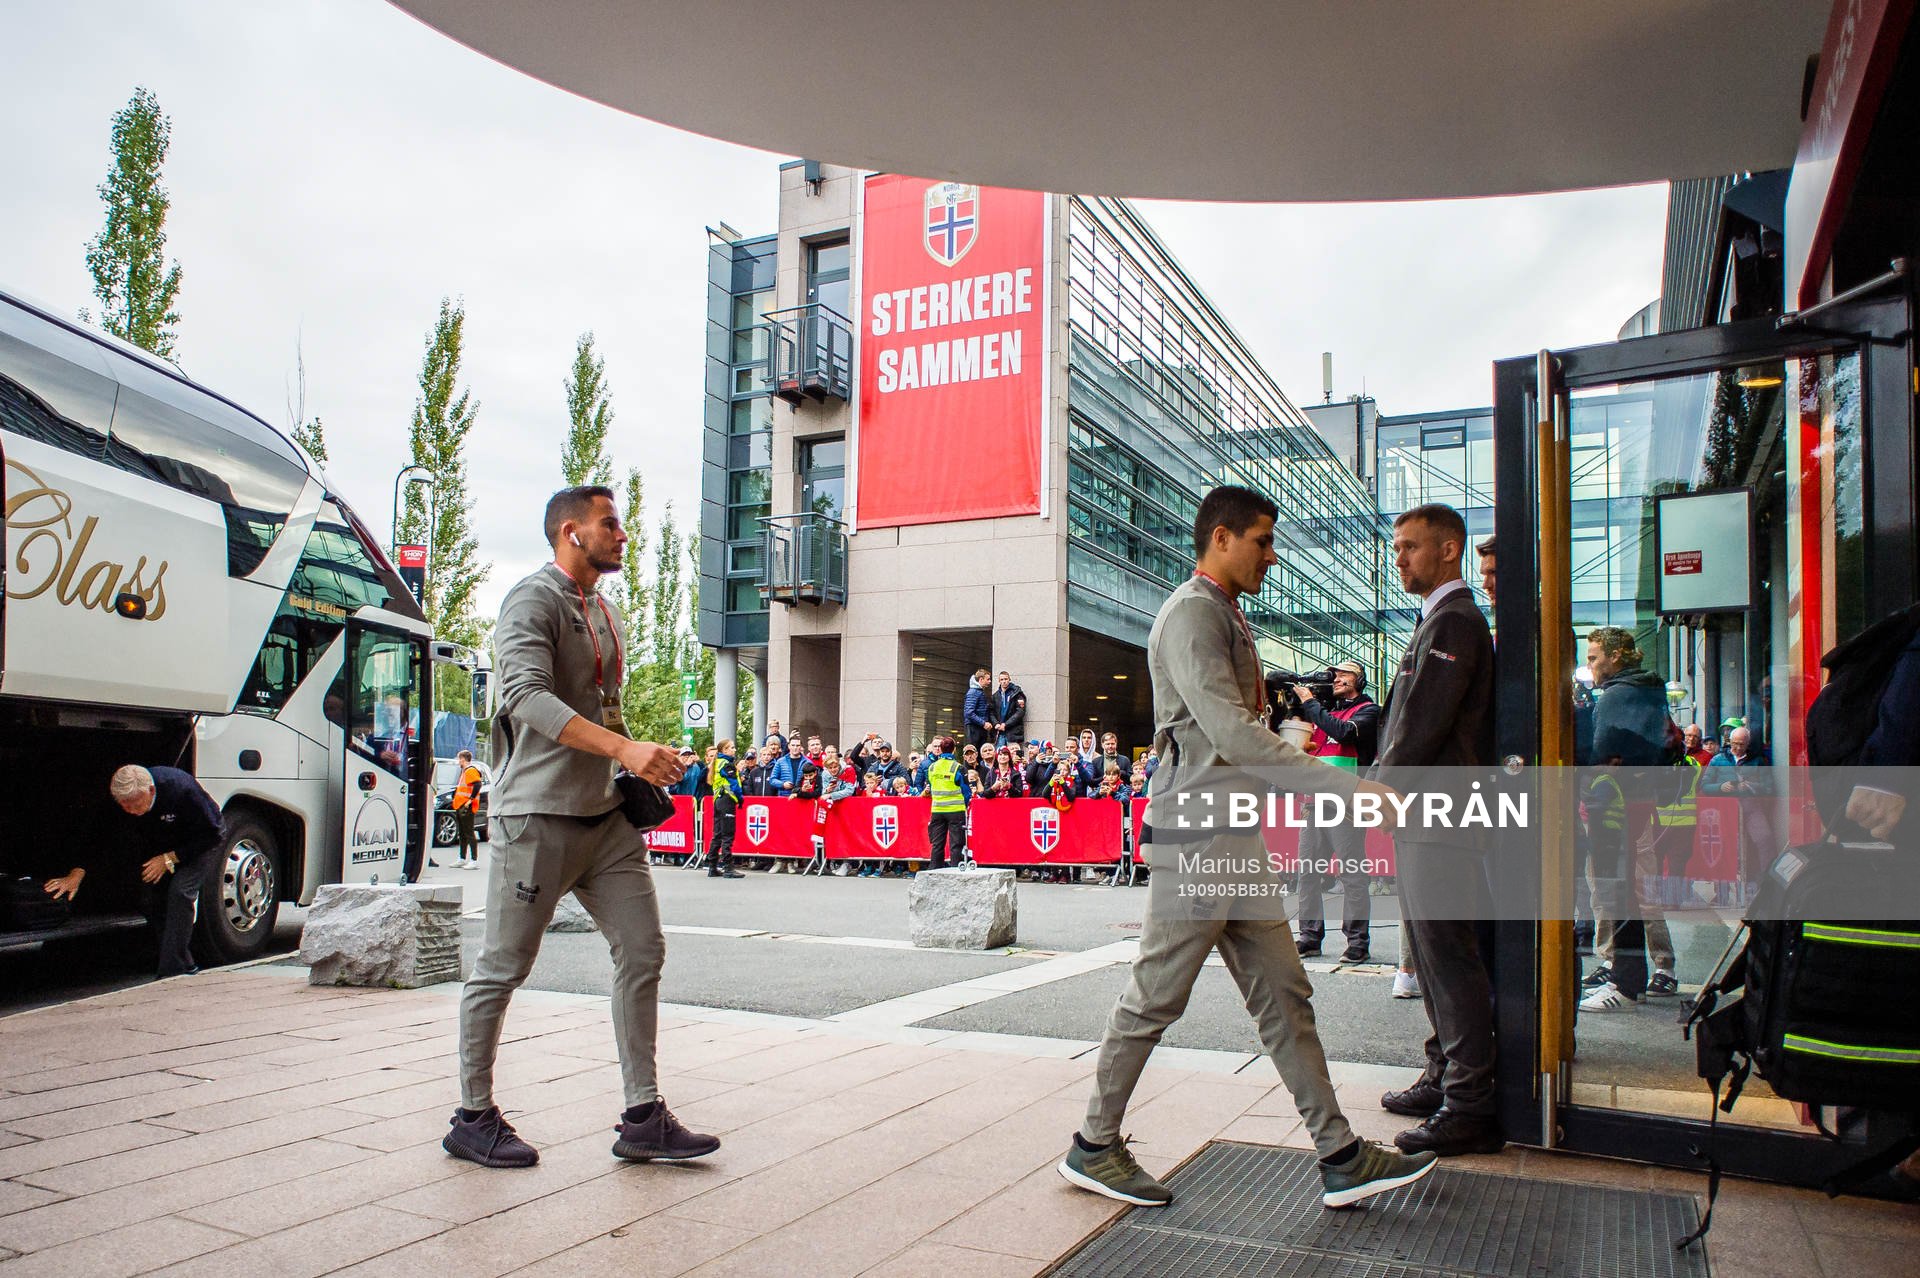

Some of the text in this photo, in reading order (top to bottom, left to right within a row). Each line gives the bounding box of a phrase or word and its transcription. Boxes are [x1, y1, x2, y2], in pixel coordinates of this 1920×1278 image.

[871, 267, 1033, 337] STERKERE
[878, 329, 1023, 393] SAMMEN
[356, 828, 395, 847] MAN
[651, 831, 686, 847] SAMMEN
[352, 847, 400, 861] NEOPLAN
